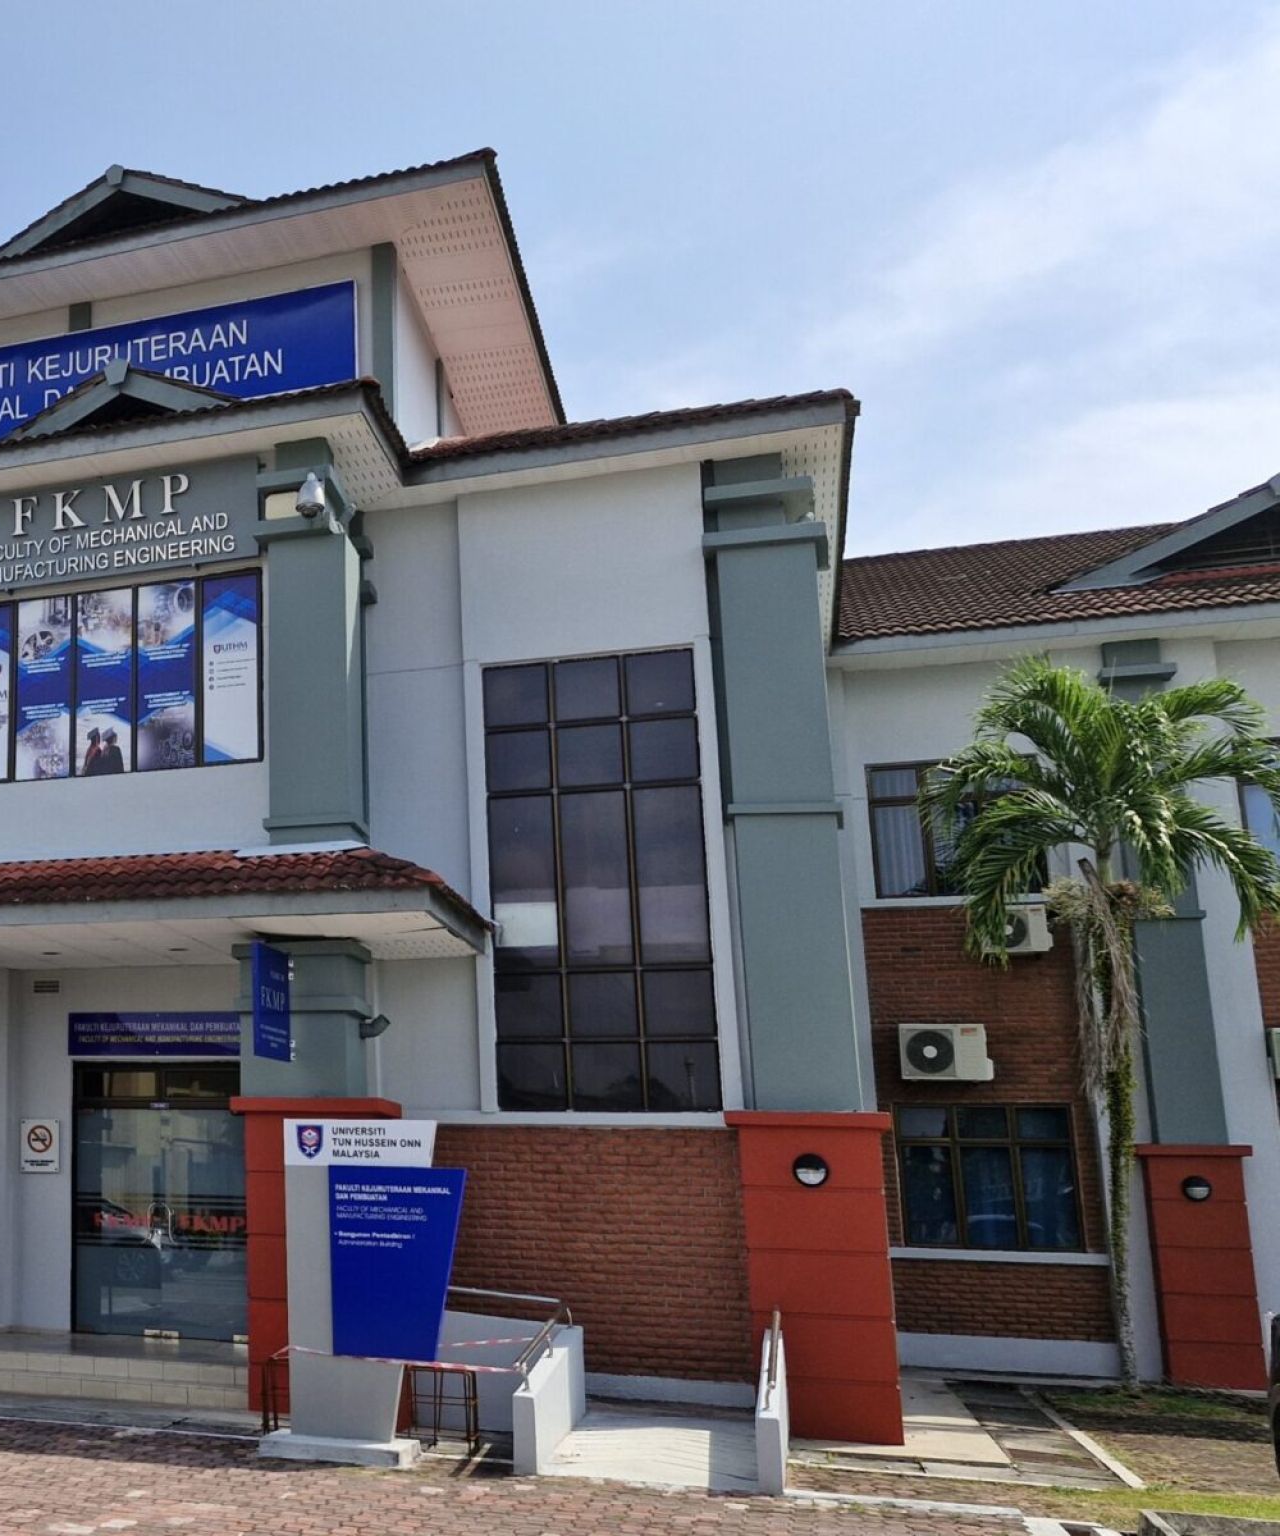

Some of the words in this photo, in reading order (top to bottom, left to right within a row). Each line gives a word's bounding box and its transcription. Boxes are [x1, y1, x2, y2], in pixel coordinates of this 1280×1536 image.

[27, 320, 247, 384] KEJURUTERAAN
[164, 349, 282, 388] BUATAN
[10, 473, 189, 536] FKMP
[49, 535, 71, 554] OF
[76, 519, 186, 549] MECHANICAL
[190, 512, 228, 533] AND
[114, 535, 235, 567] ENGINEERING
[261, 985, 285, 1012] FKMP
[332, 1127, 386, 1136] UNIVERSITI
[332, 1138, 352, 1146] TUN
[355, 1139, 397, 1147] HUSSEIN
[400, 1139, 421, 1148] ONN
[332, 1149, 380, 1158] MALAYSIA
